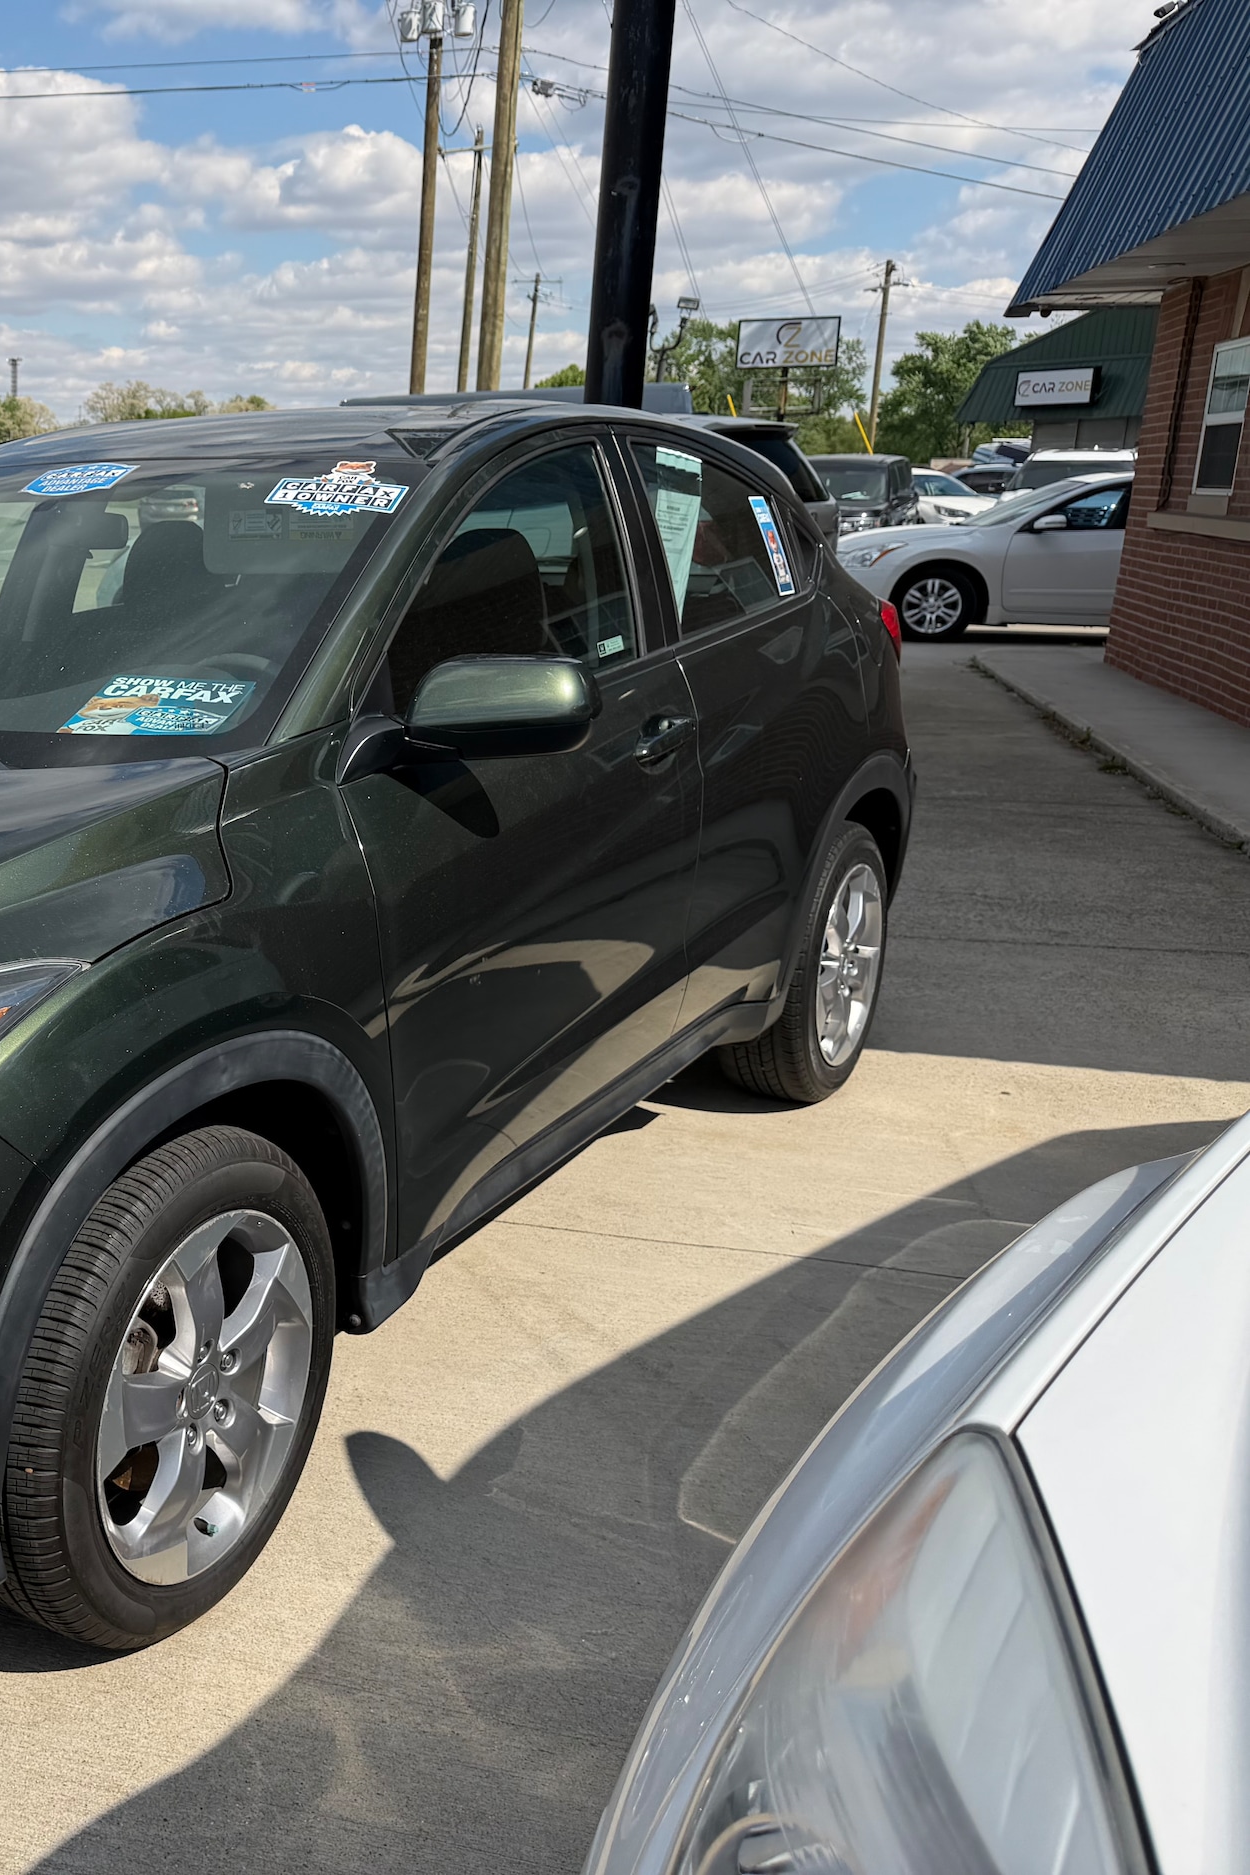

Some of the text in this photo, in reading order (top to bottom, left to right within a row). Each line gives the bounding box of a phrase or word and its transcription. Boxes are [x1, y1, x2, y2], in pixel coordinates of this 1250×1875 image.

[739, 349, 835, 365] CAR ZONE
[1031, 382, 1056, 394] CAR
[1058, 380, 1090, 393] ZONE
[38, 477, 108, 487] ADVANTAGE
[41, 484, 88, 492] DEALER
[285, 482, 396, 498] CARFAX
[296, 492, 389, 507] OWNER
[113, 677, 246, 692] SHOW ME THE
[103, 684, 239, 704] CARFAX
